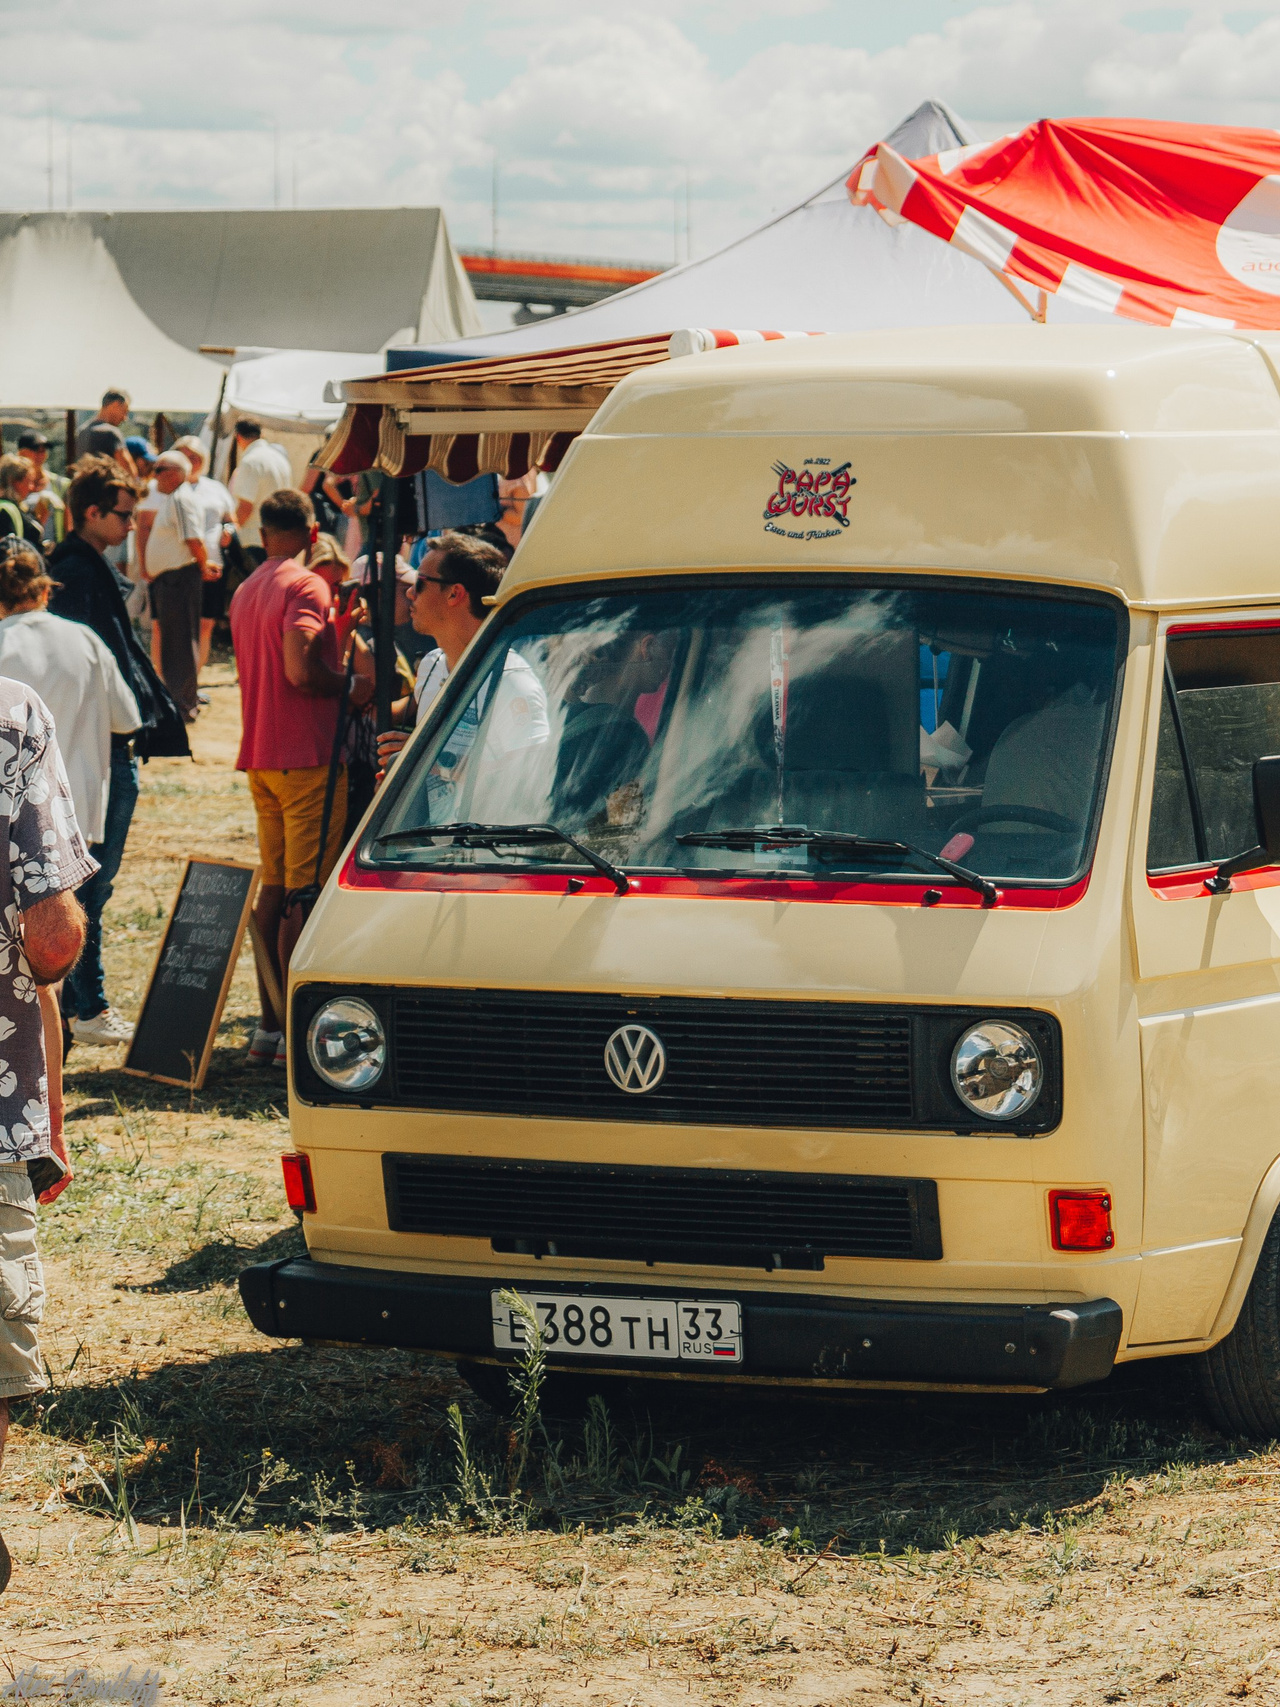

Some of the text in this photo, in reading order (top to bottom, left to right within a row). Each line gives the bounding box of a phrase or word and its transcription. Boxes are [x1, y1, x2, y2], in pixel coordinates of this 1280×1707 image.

[778, 468, 851, 498] PAPA
[764, 522, 786, 536] Essen
[787, 529, 804, 539] und
[682, 1306, 723, 1341] 33
[682, 1341, 712, 1354] RUS
